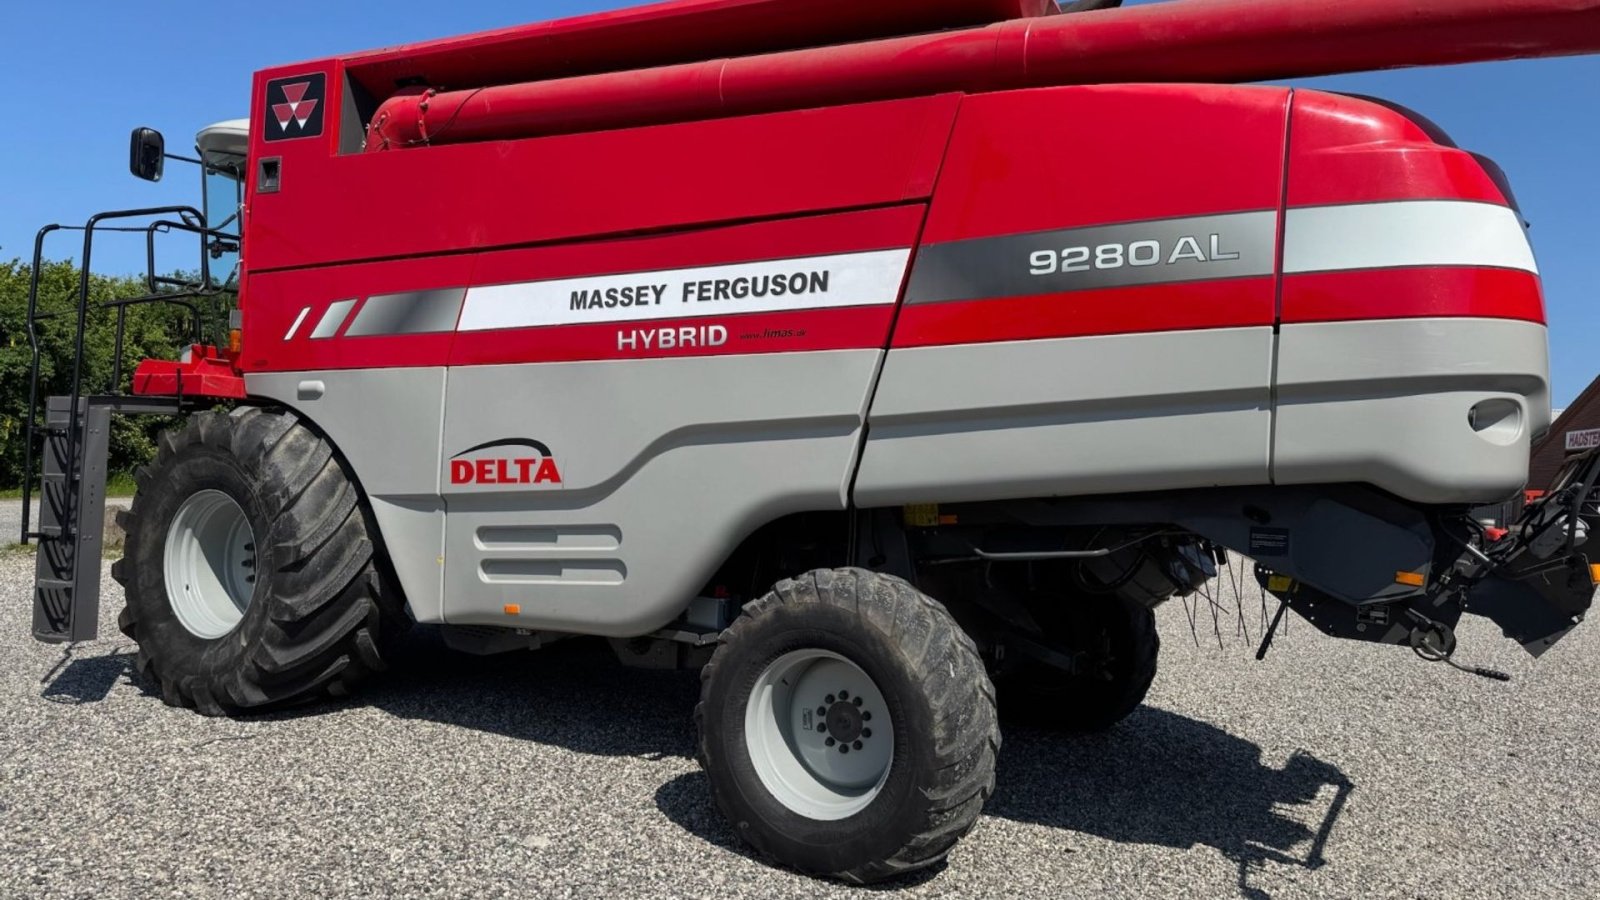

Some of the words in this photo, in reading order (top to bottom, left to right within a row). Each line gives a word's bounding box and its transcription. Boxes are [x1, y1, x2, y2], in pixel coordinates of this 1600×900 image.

[569, 284, 667, 310] MASSEY
[682, 270, 829, 302] FERGUSON
[617, 325, 728, 350] HYBRID
[1569, 431, 1600, 447] HADSTE
[451, 458, 562, 484] DELTA
